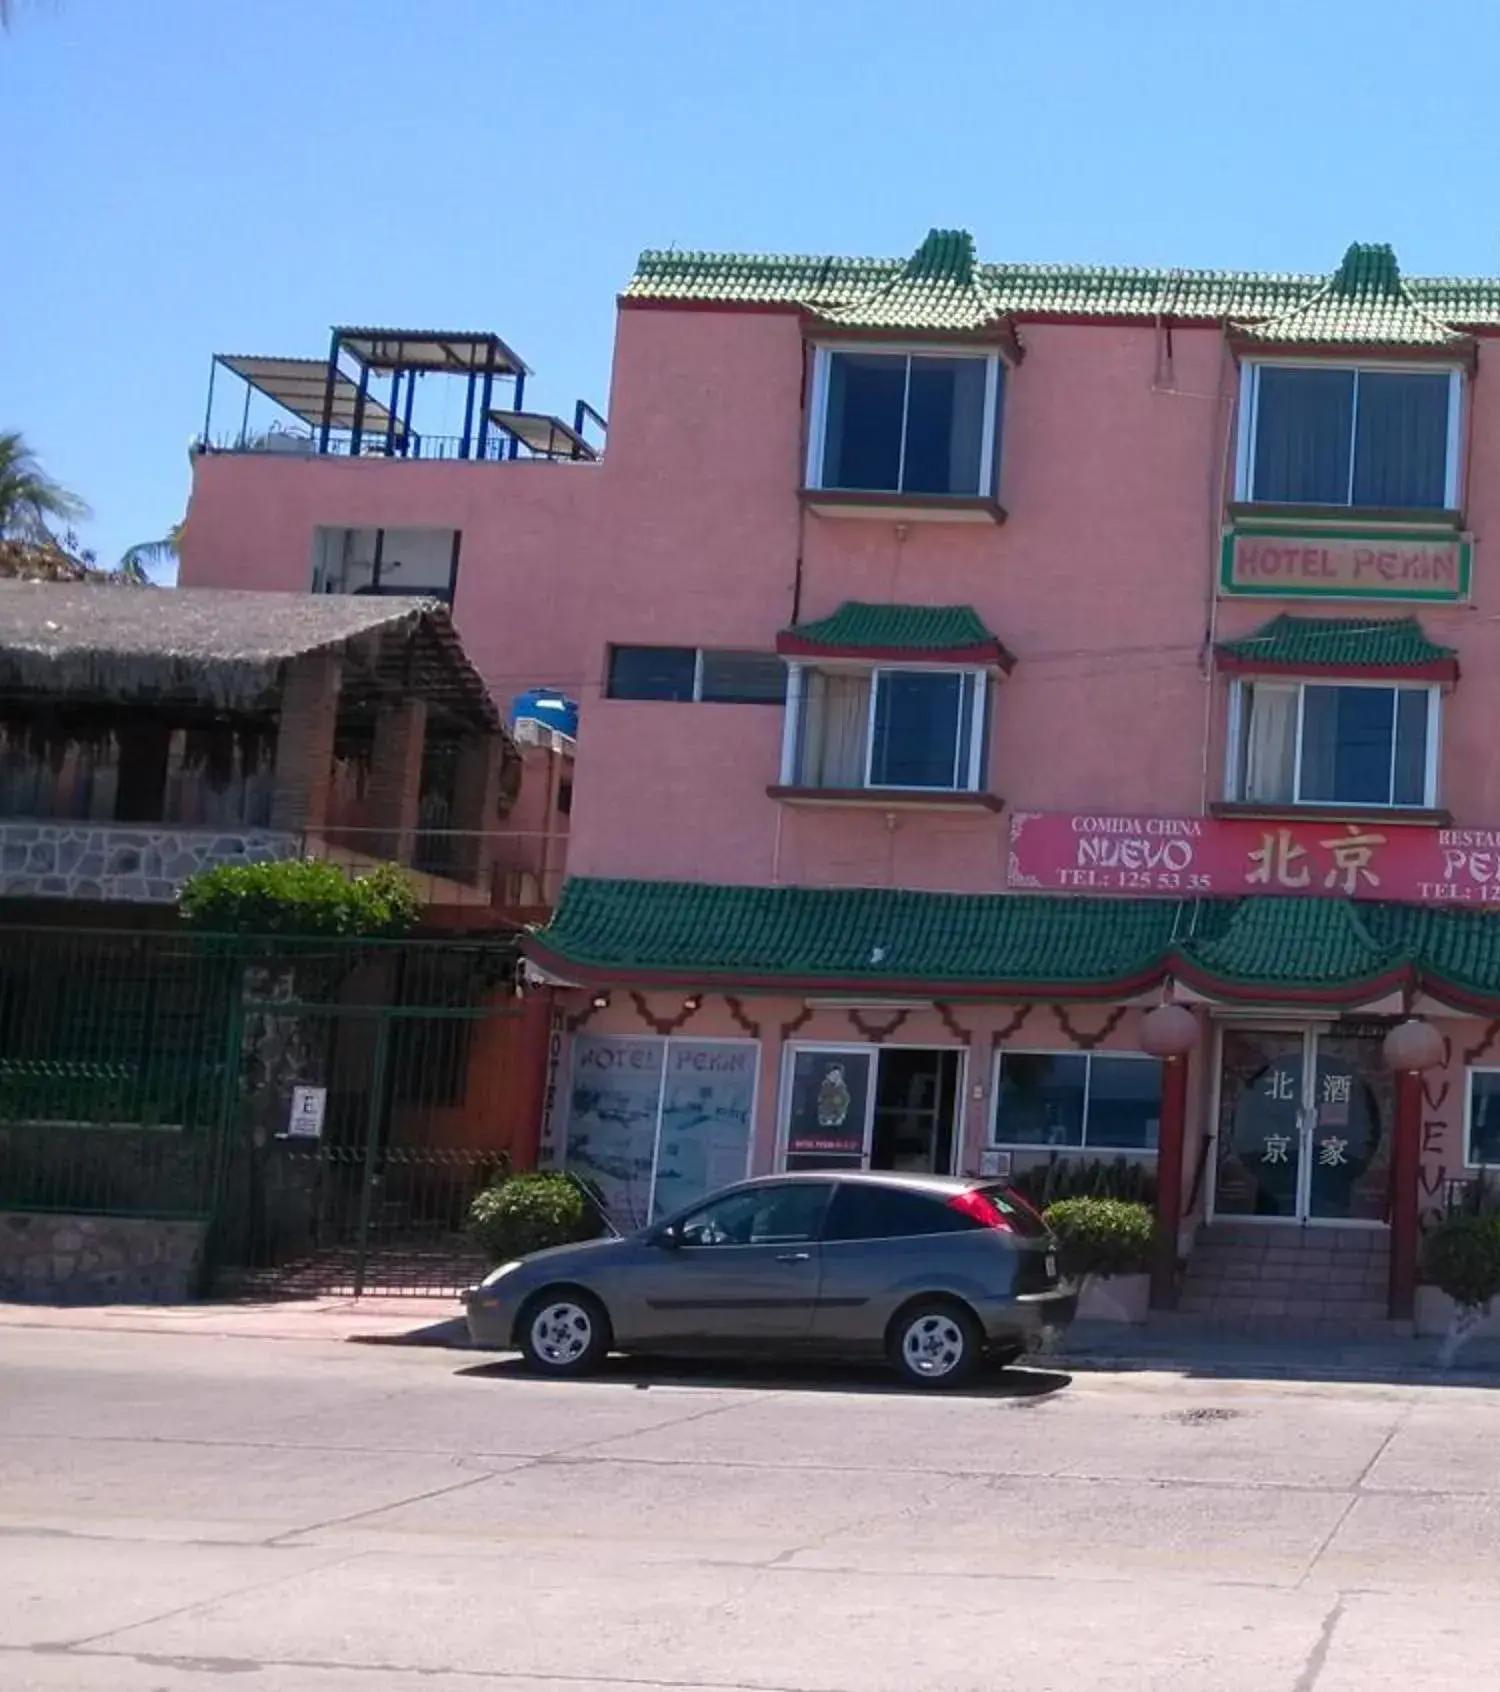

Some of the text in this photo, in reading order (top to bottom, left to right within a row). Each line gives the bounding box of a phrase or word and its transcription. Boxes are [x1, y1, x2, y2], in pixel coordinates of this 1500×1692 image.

[1237, 545, 1456, 582] HOTEL PEKIN
[1071, 815, 1202, 837] COMIDA CHINA
[1077, 837, 1194, 871] NUEVO
[1244, 826, 1389, 897] 北京
[1118, 870, 1150, 889] 125
[1157, 872, 1181, 890] 53
[1186, 874, 1211, 891] 35
[579, 1046, 658, 1070] HOTEL
[1261, 1070, 1296, 1165] 北京
